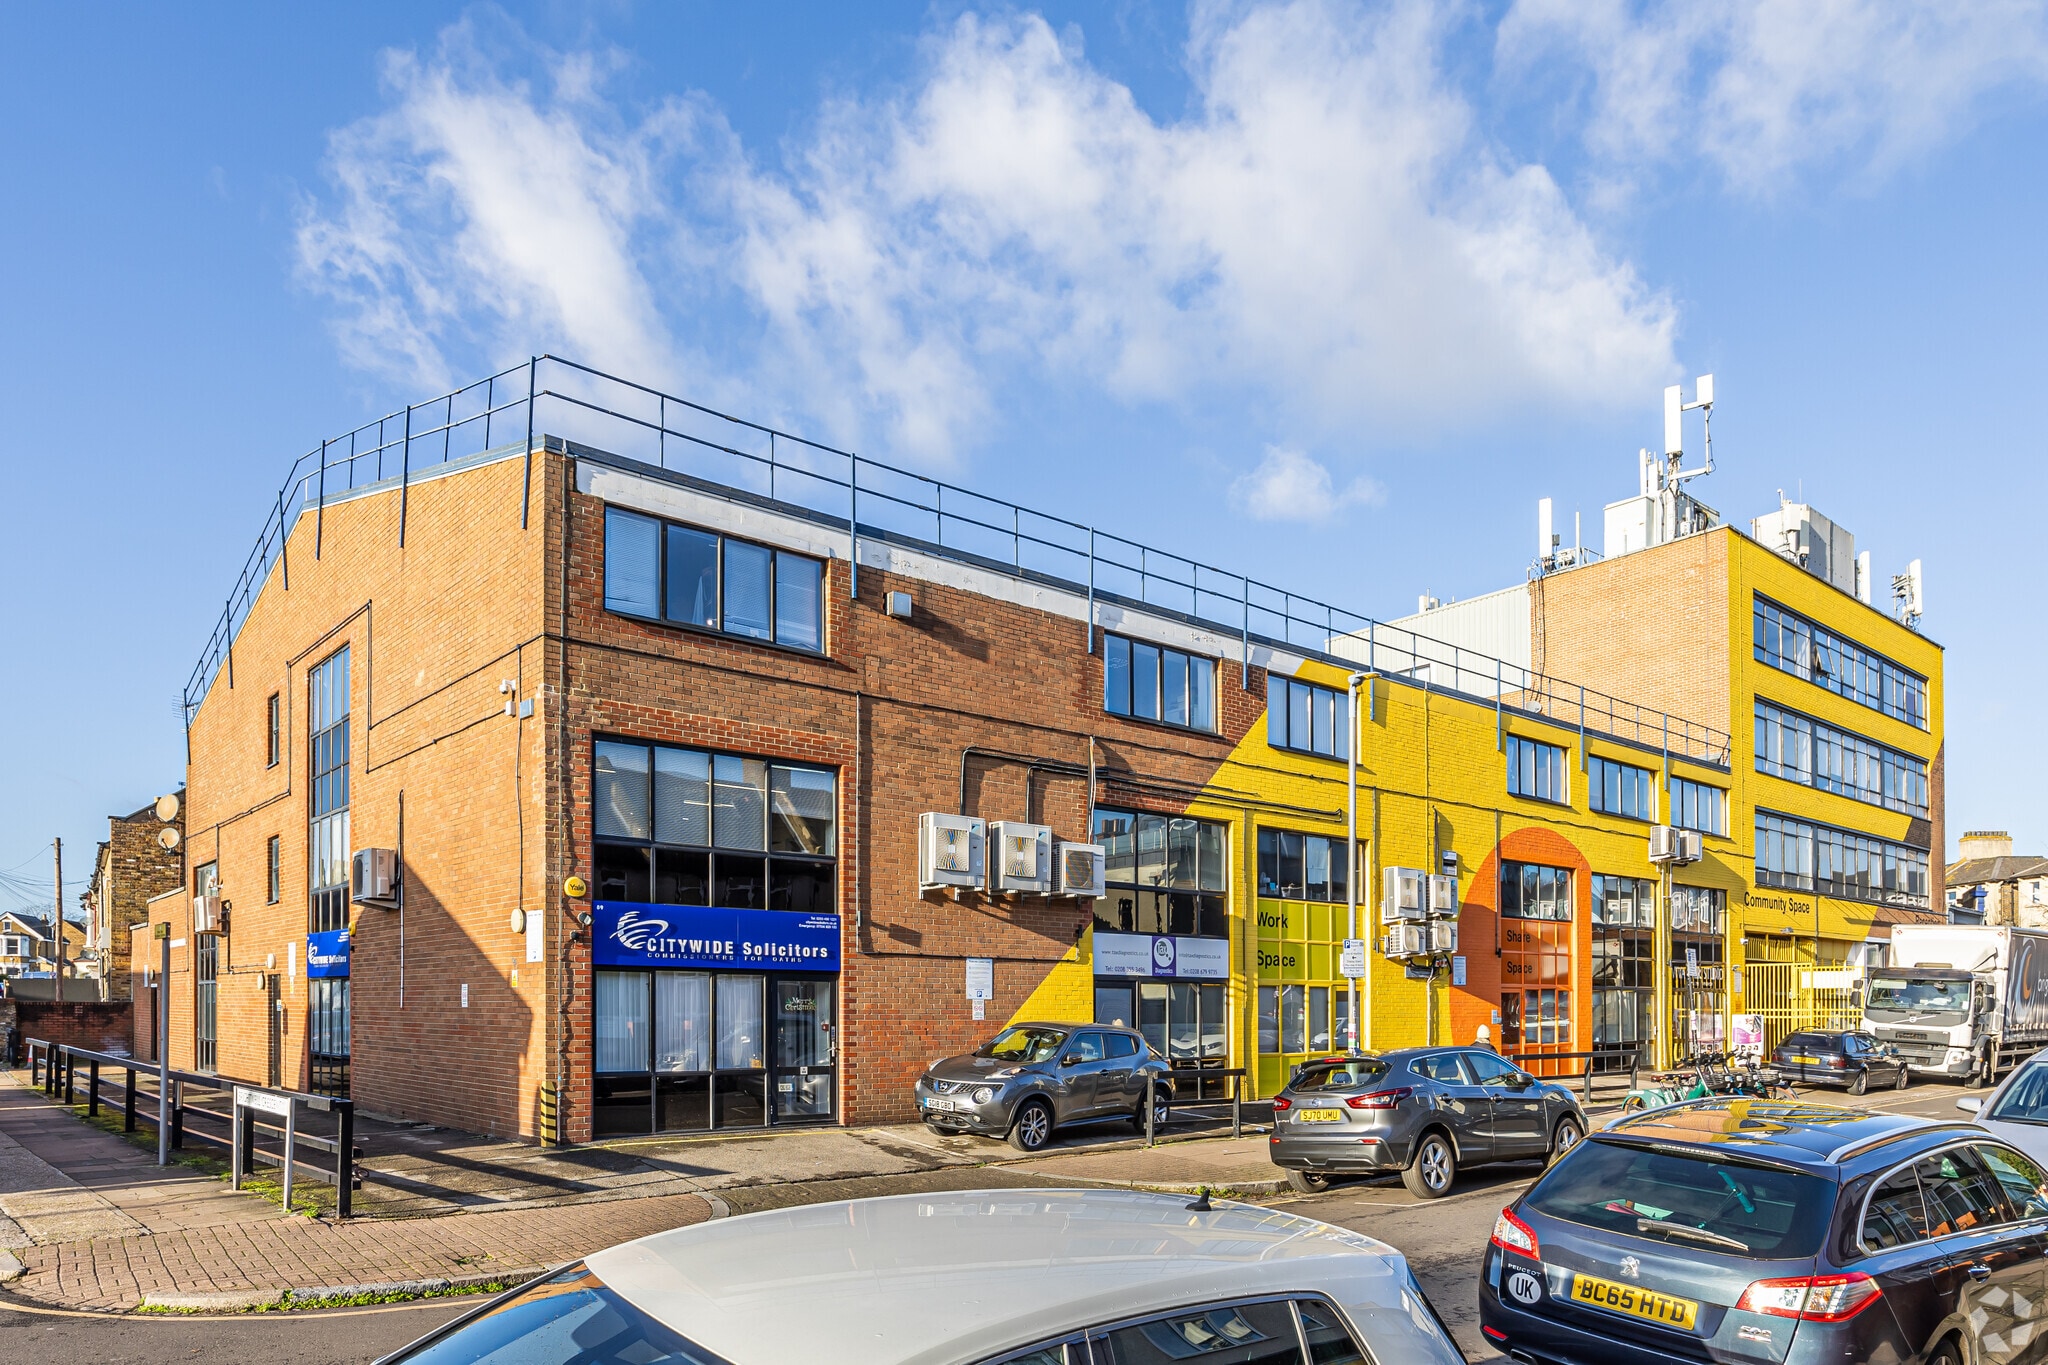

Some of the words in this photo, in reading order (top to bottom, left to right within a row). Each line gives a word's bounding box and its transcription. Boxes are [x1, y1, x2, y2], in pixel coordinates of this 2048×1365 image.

[1744, 891, 1787, 914] Community
[1788, 897, 1810, 916] Space
[1258, 911, 1288, 929] Work
[1506, 929, 1531, 943] Share
[647, 938, 734, 955] CITYWIDE
[742, 942, 828, 958] Solicitors
[647, 952, 734, 961] COMMISSIONERS
[1258, 950, 1296, 969] Space
[1506, 961, 1532, 976] Space
[1303, 1111, 1321, 1120] SJ70
[1322, 1111, 1338, 1120] UMU
[1507, 1263, 1541, 1277] PEUGEOT
[1515, 1277, 1534, 1300] UK
[1579, 1279, 1635, 1310] BC65
[1638, 1293, 1687, 1323] HTD
